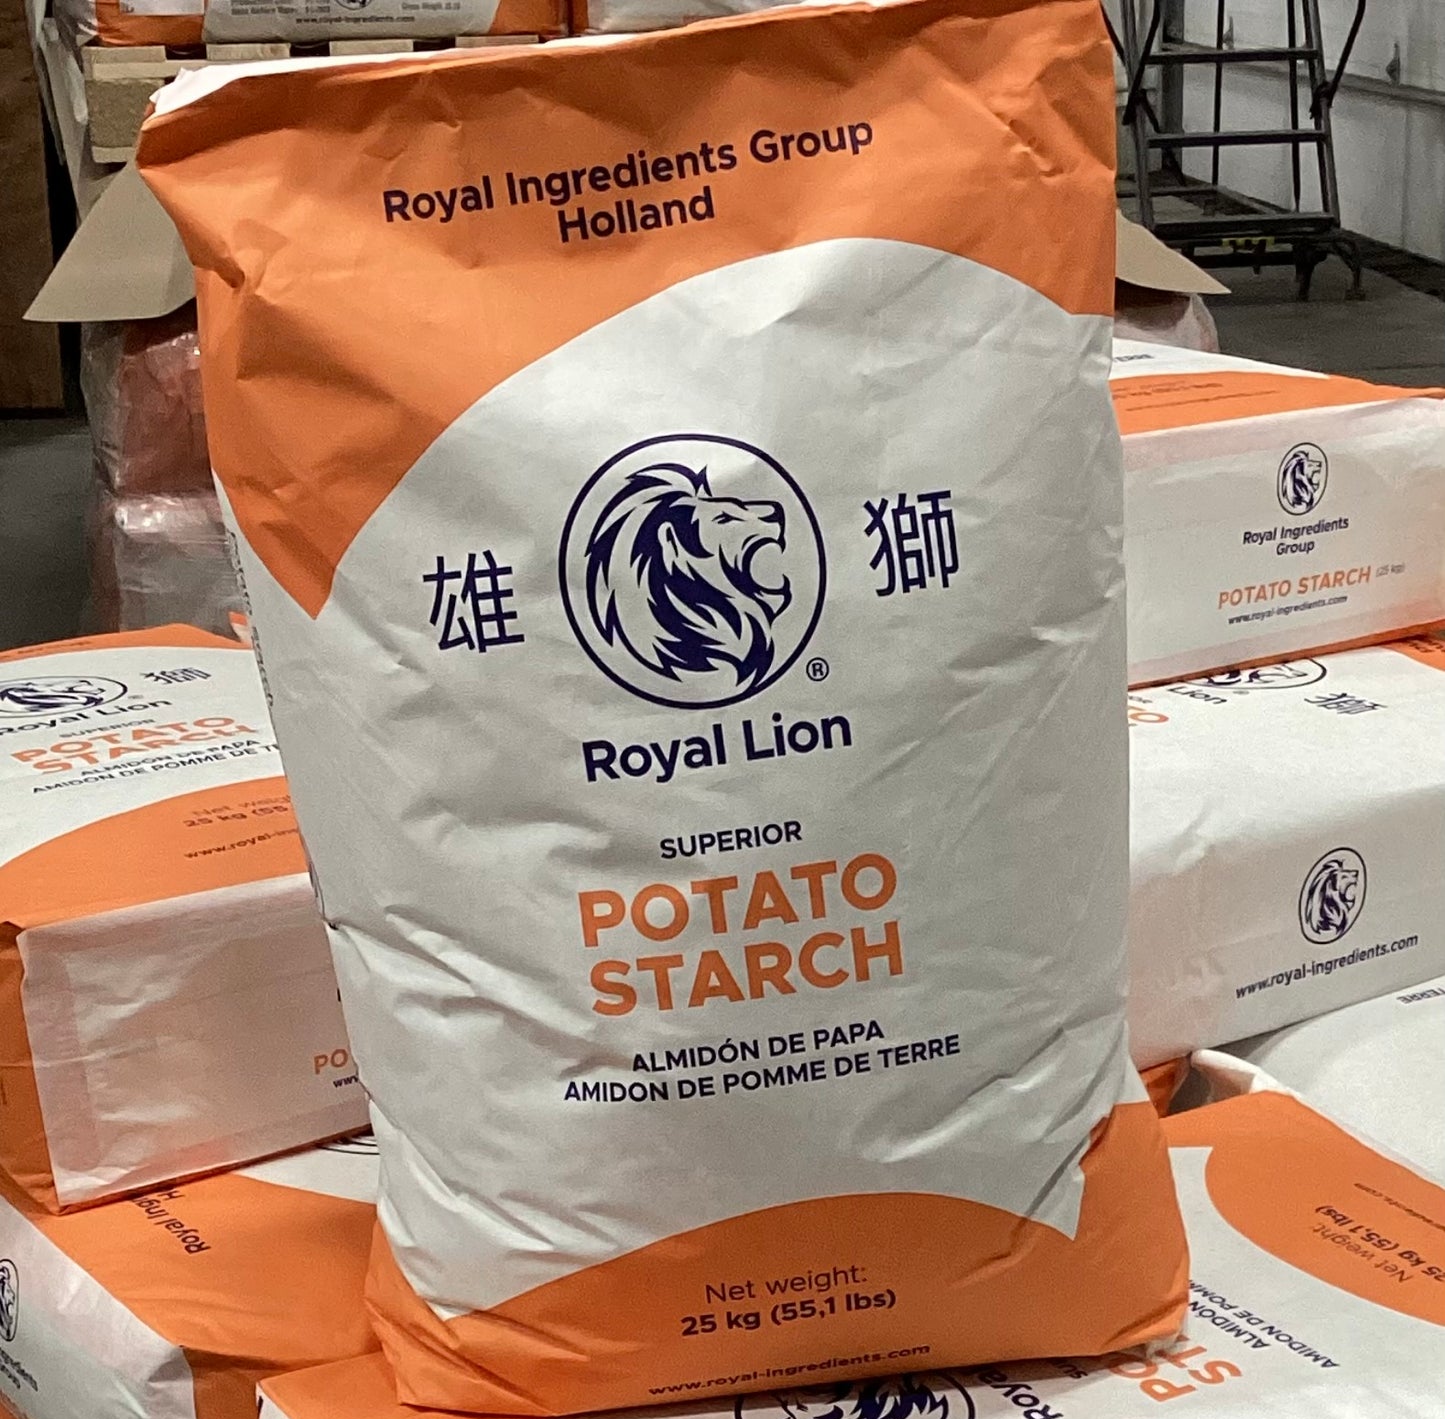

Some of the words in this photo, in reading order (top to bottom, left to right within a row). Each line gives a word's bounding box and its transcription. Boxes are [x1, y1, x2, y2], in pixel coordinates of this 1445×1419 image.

[383, 176, 494, 223] Royal
[506, 141, 737, 205] Ingredients
[750, 121, 873, 163] Group
[558, 187, 715, 243] Holland
[1242, 527, 1277, 545] Royal
[1280, 517, 1349, 540] Ingredients
[1276, 540, 1315, 556] Group
[423, 550, 524, 653] 雄
[864, 490, 960, 597] 獅
[1218, 580, 1291, 610] POTATO
[1297, 566, 1371, 595] STARCH
[1228, 595, 1348, 625] www.royal-ingredients.com
[96, 700, 172, 716] Lion
[1167, 684, 1228, 705] Lion
[11, 717, 235, 763] POTATO
[59, 718, 156, 738] SUPERIOR
[206, 740, 260, 753] PAPA
[582, 724, 727, 783] Royal
[744, 712, 852, 763] Lion
[33, 725, 257, 775] STARCH
[33, 772, 115, 794] AMIDON
[120, 767, 146, 779] DE
[152, 753, 226, 771] POMME
[230, 747, 258, 758] DE
[252, 805, 288, 816] (55
[660, 821, 802, 859] SUPERIOR
[578, 853, 897, 947] POTATO
[590, 920, 903, 1016] STARCH
[1235, 935, 1419, 999] www.royal-ingredients.com
[632, 1038, 759, 1073] ALMIDÓN
[769, 1032, 805, 1057] DE
[813, 1020, 885, 1050] PAPA
[564, 1081, 669, 1102] AMIDON
[677, 1076, 715, 1099] DE
[723, 1059, 827, 1094] POMME
[834, 1052, 871, 1077] DE
[877, 1035, 960, 1068] TERRE
[154, 1218, 211, 1254] Royal
[1315, 1205, 1354, 1226] lbs)
[1374, 1260, 1413, 1283] Net
[1398, 1250, 1426, 1267] kg
[705, 1280, 756, 1304] Net
[765, 1265, 868, 1293] weight:
[681, 1313, 717, 1336] 25
[727, 1310, 760, 1331] kg
[771, 1296, 836, 1326] (55,1
[846, 1289, 897, 1311] lbs)
[1233, 1310, 1265, 1326] DE
[1262, 1325, 1340, 1368] AMIDON
[648, 1344, 931, 1395] www.royal-ingredients.com
